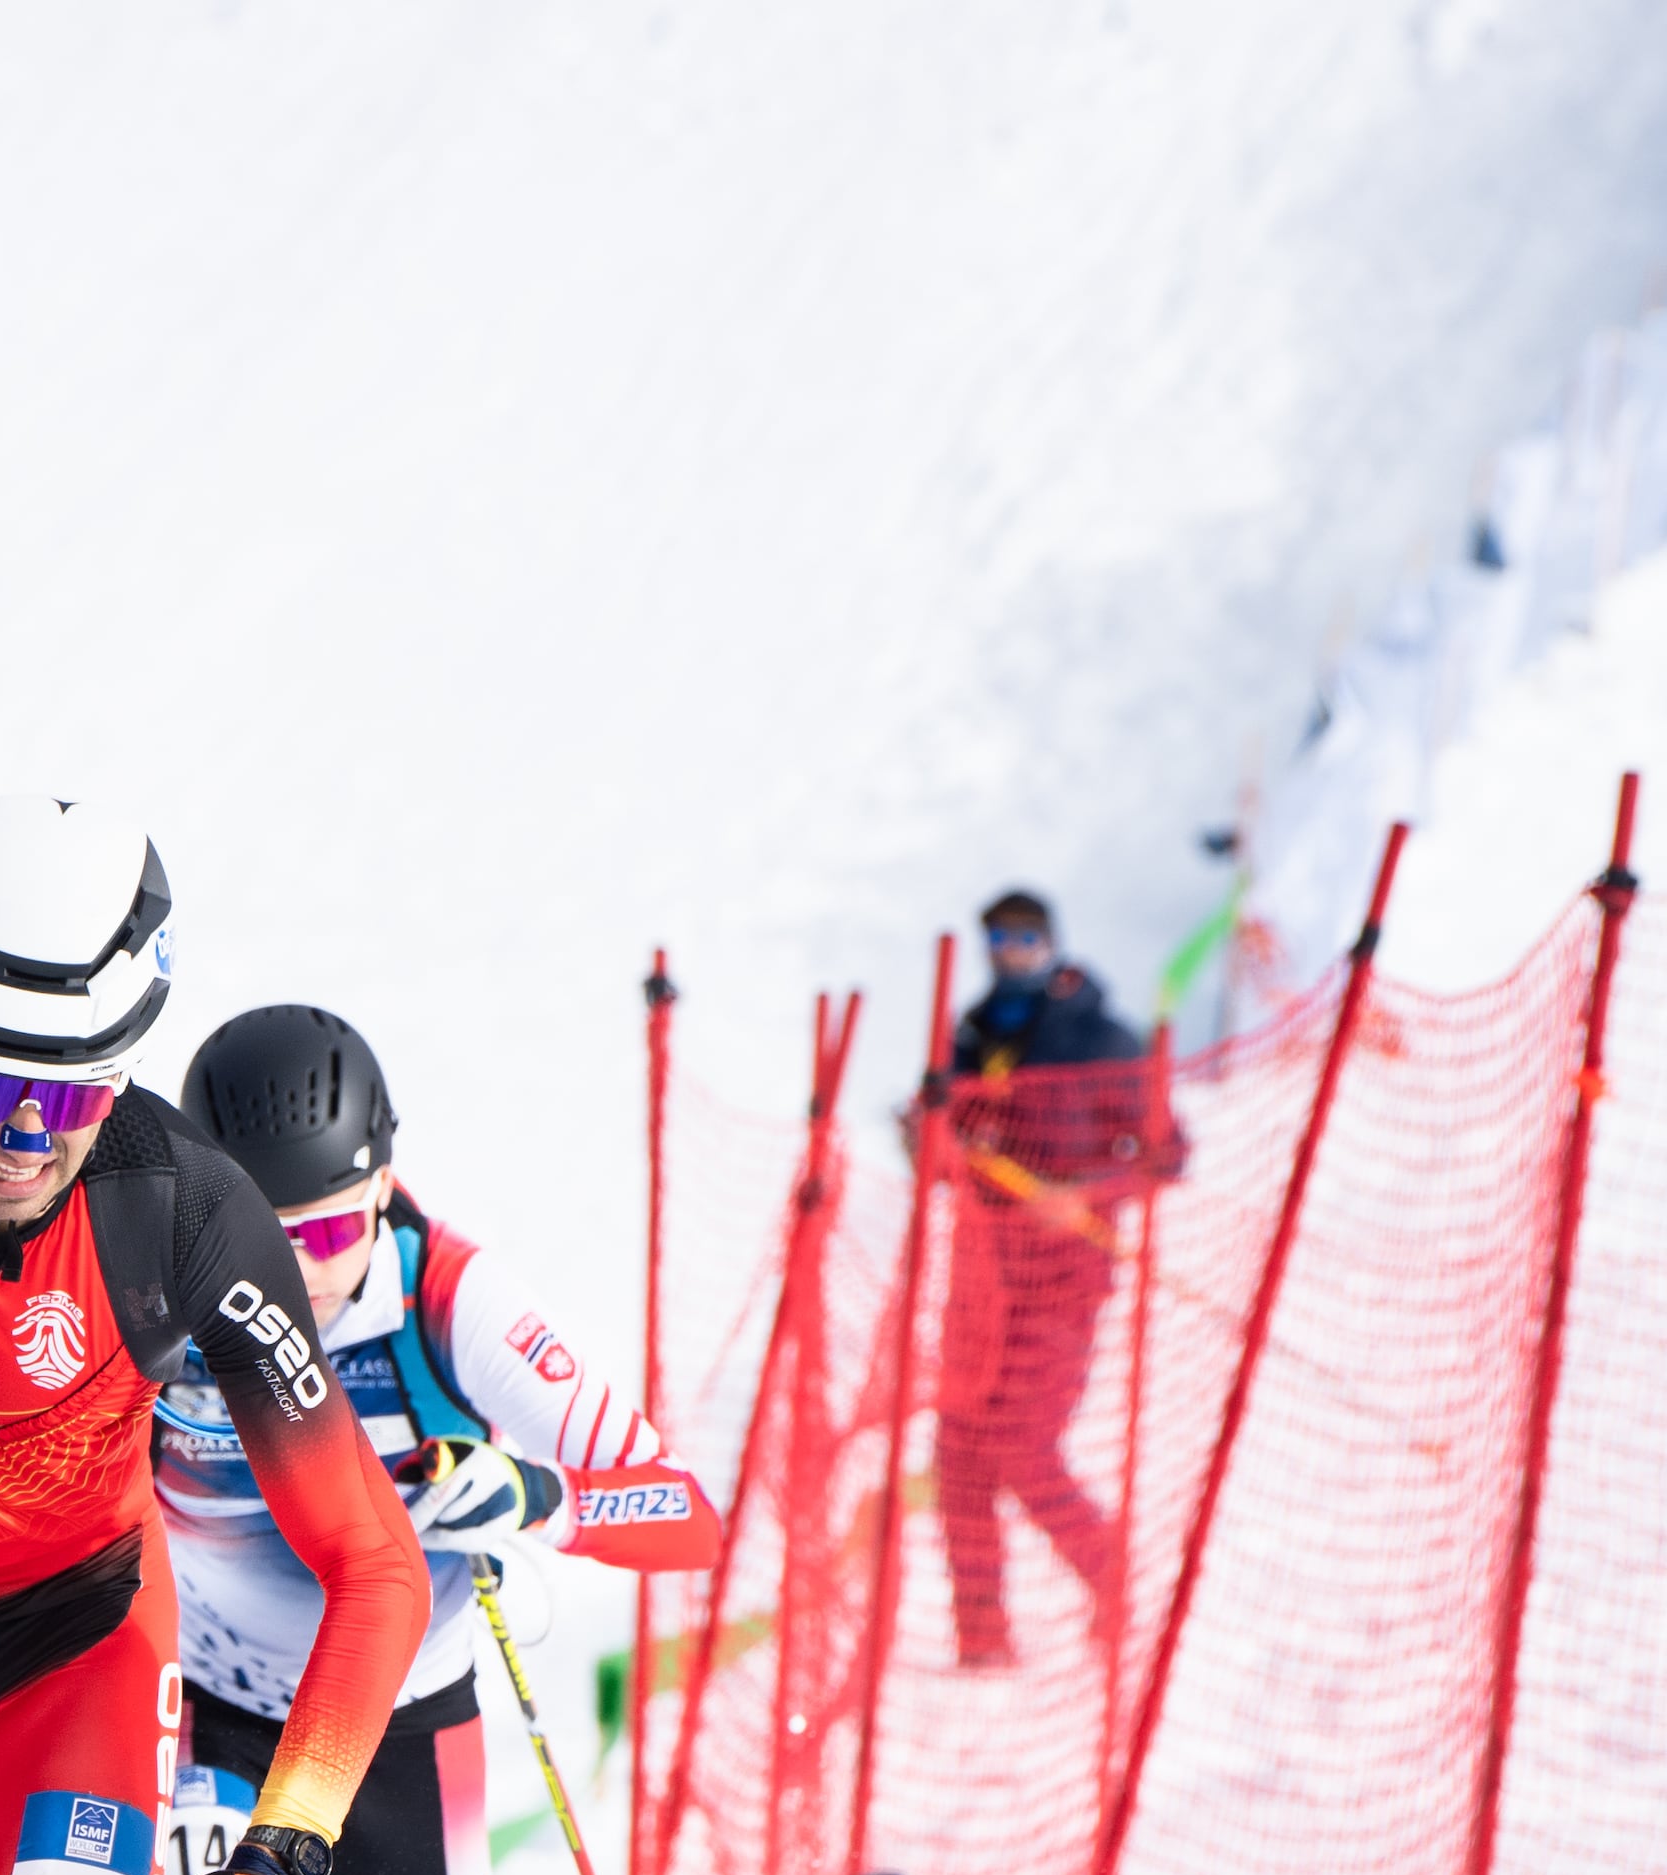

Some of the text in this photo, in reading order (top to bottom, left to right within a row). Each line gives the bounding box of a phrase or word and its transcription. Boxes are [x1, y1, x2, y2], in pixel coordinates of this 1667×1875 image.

[89, 1062, 117, 1073] ATOMIC
[218, 1280, 328, 1410] OS2O
[255, 1357, 304, 1422] FAST&LIGHT
[74, 1824, 110, 1842] ISMF
[94, 1844, 110, 1853] CUP
